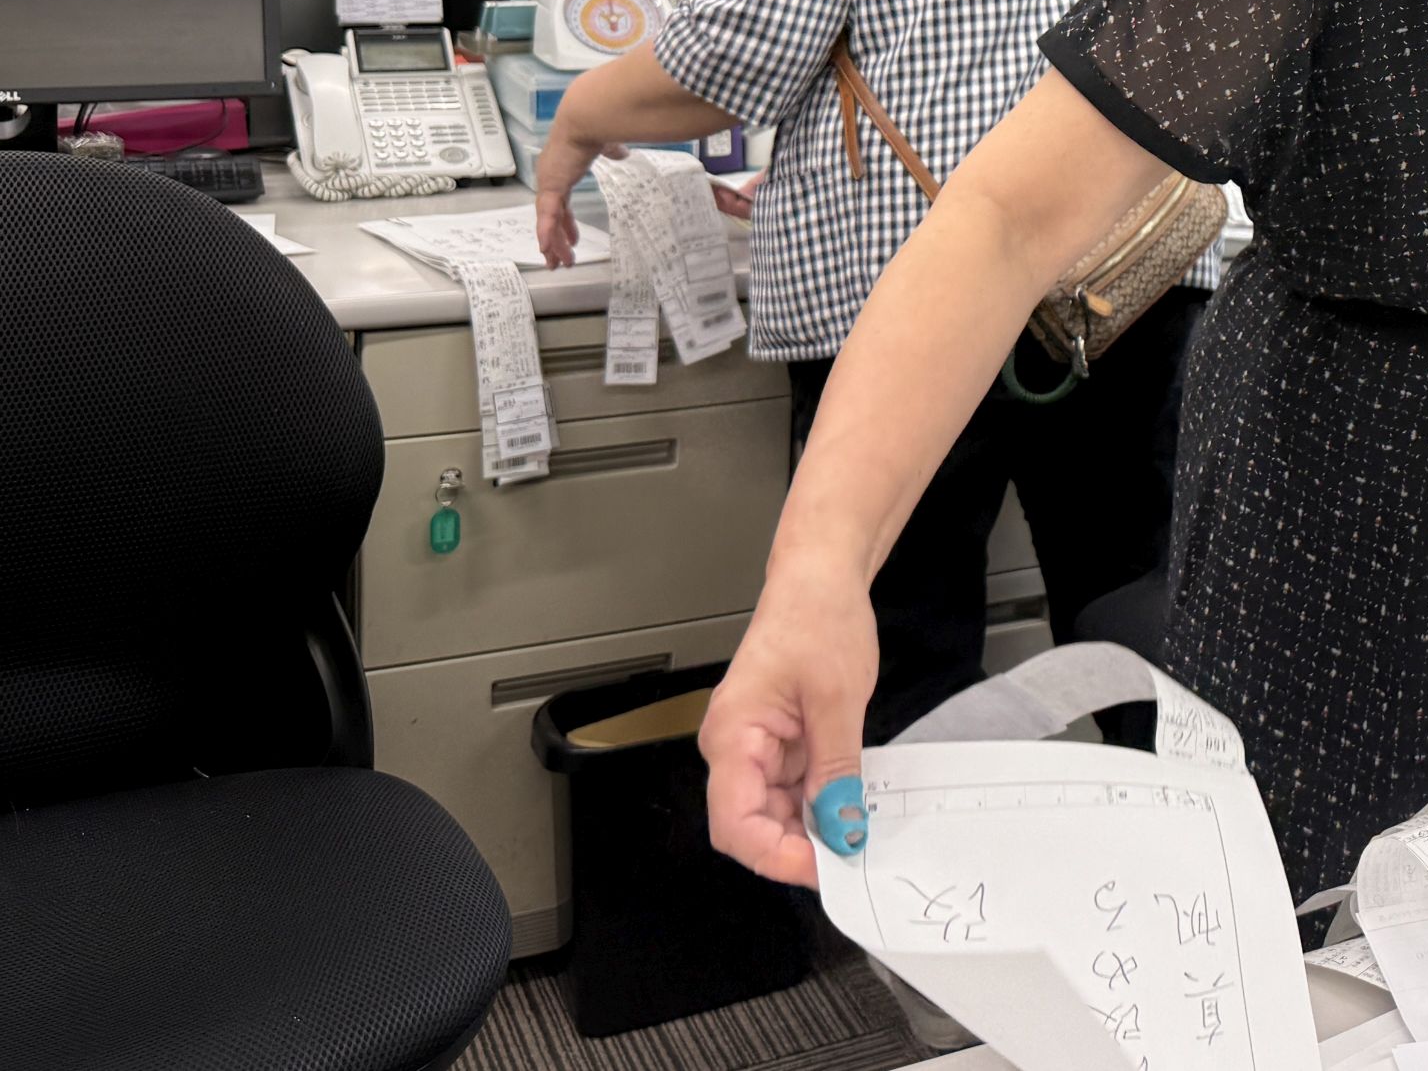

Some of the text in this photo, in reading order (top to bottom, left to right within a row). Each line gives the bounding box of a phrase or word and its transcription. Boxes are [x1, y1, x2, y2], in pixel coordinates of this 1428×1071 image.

[894, 876, 987, 943] 改
[1087, 879, 1150, 1071] 改める
[1153, 891, 1236, 1047] 真帆
